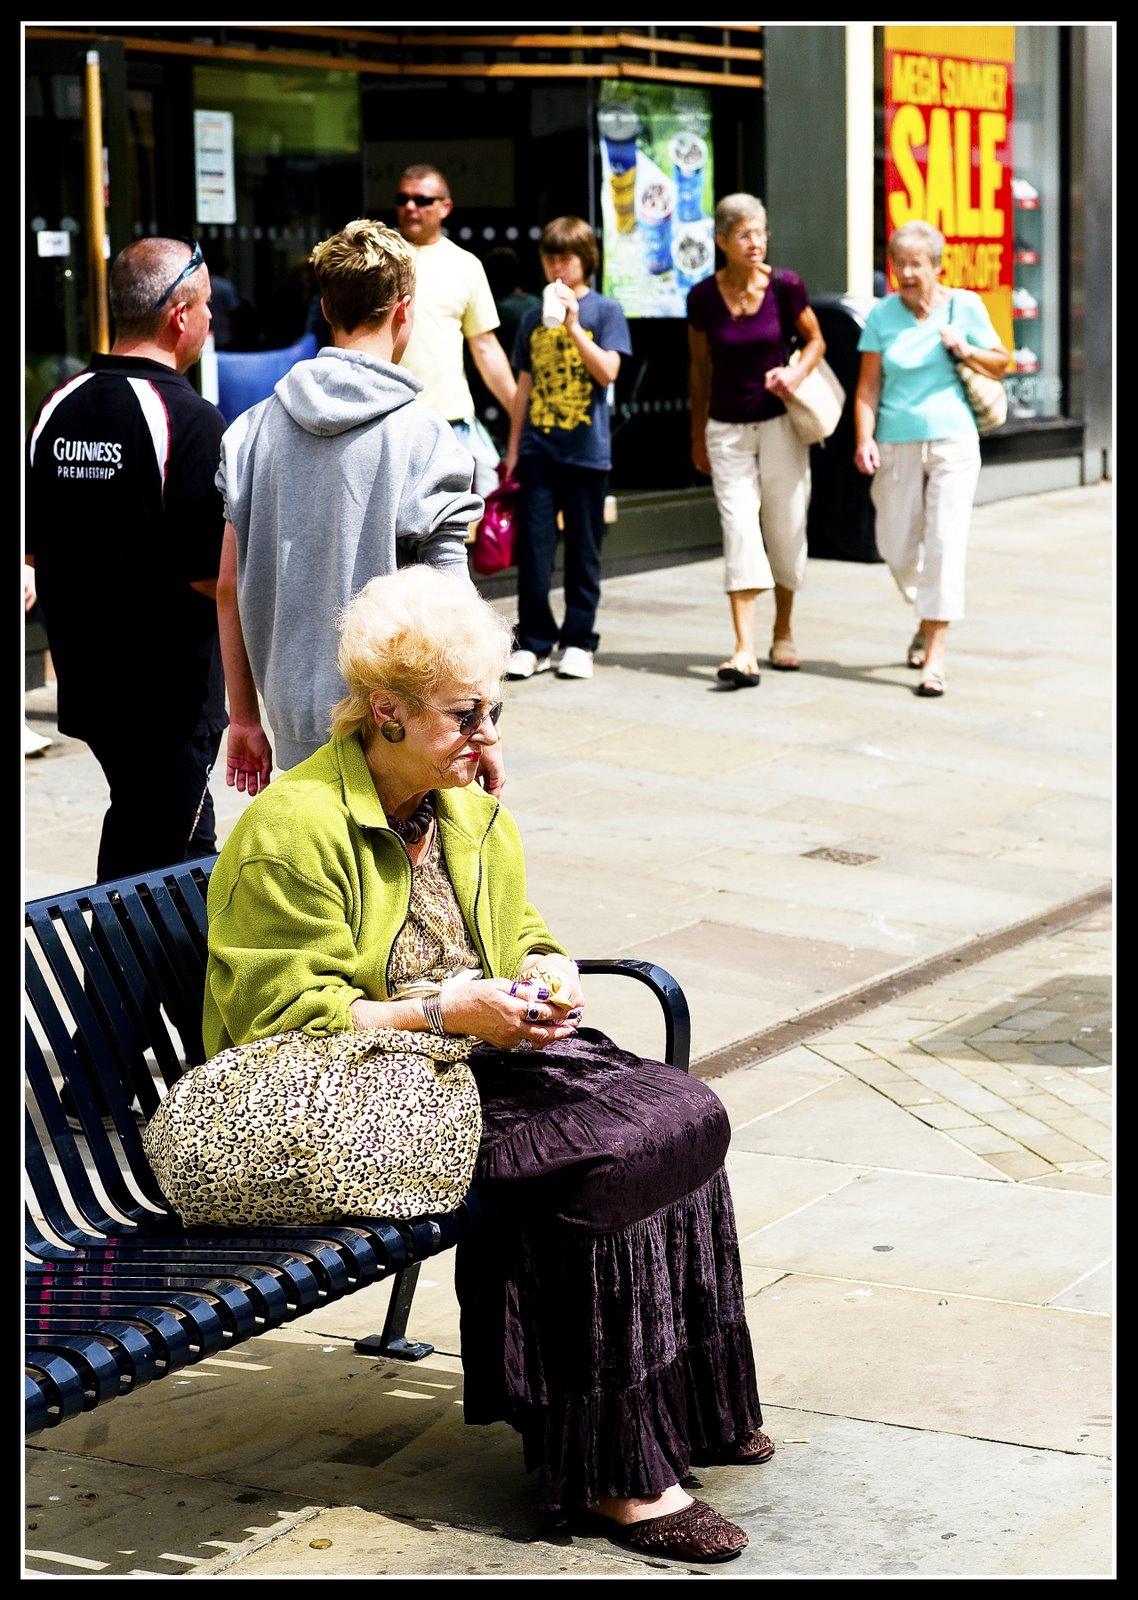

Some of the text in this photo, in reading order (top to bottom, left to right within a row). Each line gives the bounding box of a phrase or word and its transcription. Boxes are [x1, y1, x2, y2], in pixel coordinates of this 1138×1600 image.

[892, 53, 1007, 111] MEGA SUMMER
[888, 103, 1007, 238] SALE
[53, 437, 122, 463] GUINNESS
